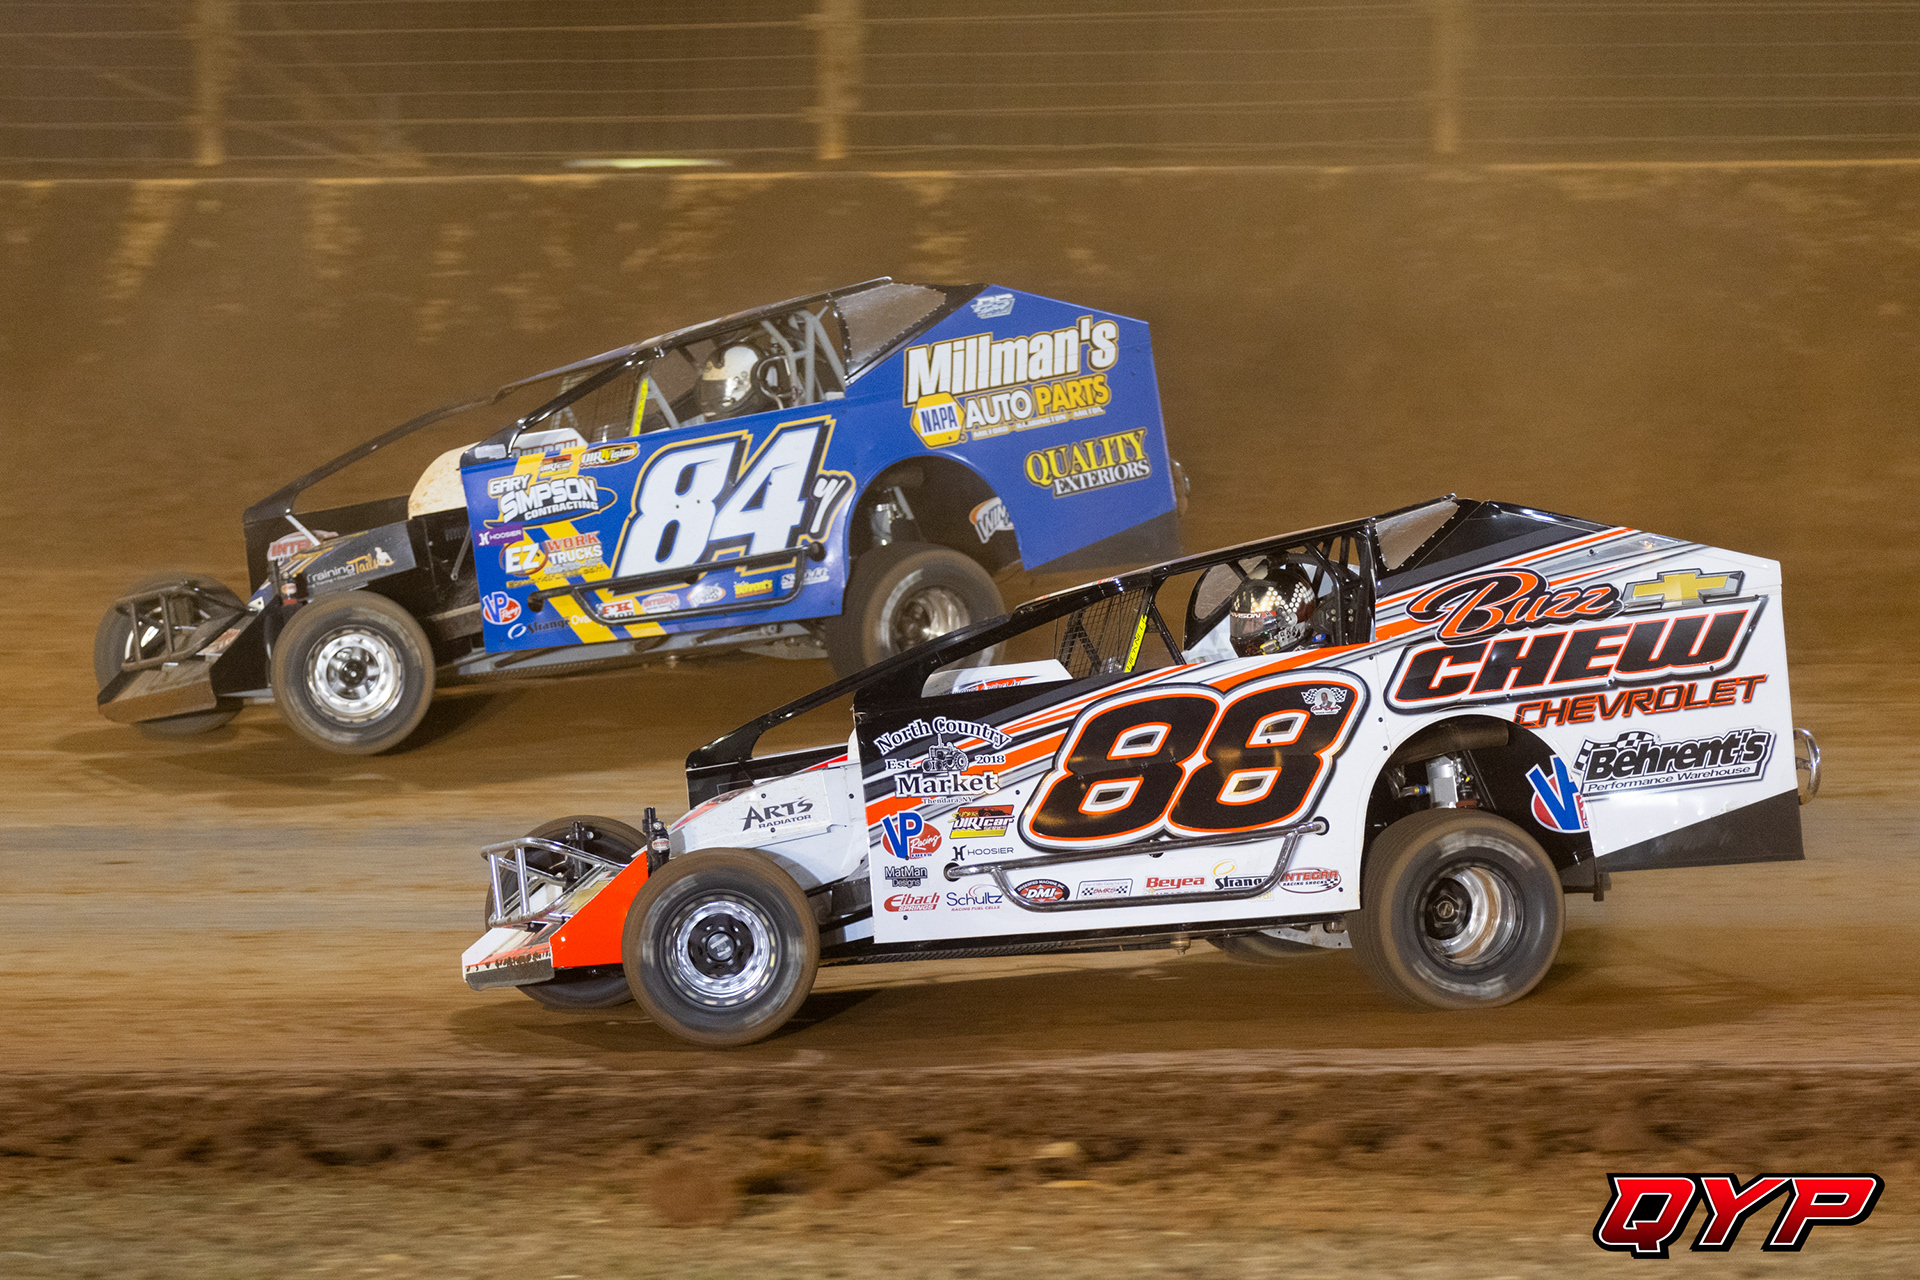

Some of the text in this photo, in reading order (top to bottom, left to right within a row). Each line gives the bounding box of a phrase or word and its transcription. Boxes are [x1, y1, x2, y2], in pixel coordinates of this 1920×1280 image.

[907, 318, 1116, 403] Millman's
[965, 375, 1110, 429] AUTO PARTS
[920, 404, 958, 433] NAPA
[1026, 430, 1144, 485] QUALITY
[489, 474, 531, 496] GARY
[1053, 459, 1150, 495] EXTERIORS
[500, 477, 598, 523] SIMPSON
[524, 500, 600, 521] CONTRACTING
[616, 426, 820, 577] 84
[546, 531, 600, 552] WORK
[505, 542, 540, 574] EZ
[548, 545, 603, 565] TRUCKS
[482, 591, 509, 624] VP
[1409, 571, 1615, 638] Buzz
[1394, 607, 1749, 703] CHEW
[1514, 674, 1769, 729] CHEVROLET
[875, 717, 1012, 755] North Country
[886, 755, 1006, 770] Est. 2018
[1027, 679, 1361, 842] 88
[1585, 732, 1770, 781] Behrent's
[898, 773, 997, 796] Market
[1587, 766, 1751, 792] Performance Warehouse
[758, 814, 812, 830] RADIATOR
[953, 816, 1015, 830] DIRTcar
[882, 812, 941, 860] VP Racing
[967, 846, 1015, 856] HOOSIER
[884, 865, 928, 878] MatMan
[892, 878, 921, 888] Designs
[1145, 876, 1205, 889] Beyea
[883, 892, 941, 912] Eibach
[946, 891, 1003, 907] Schultz
[1026, 887, 1057, 899] DMI
[898, 903, 935, 912] SPRINGS
